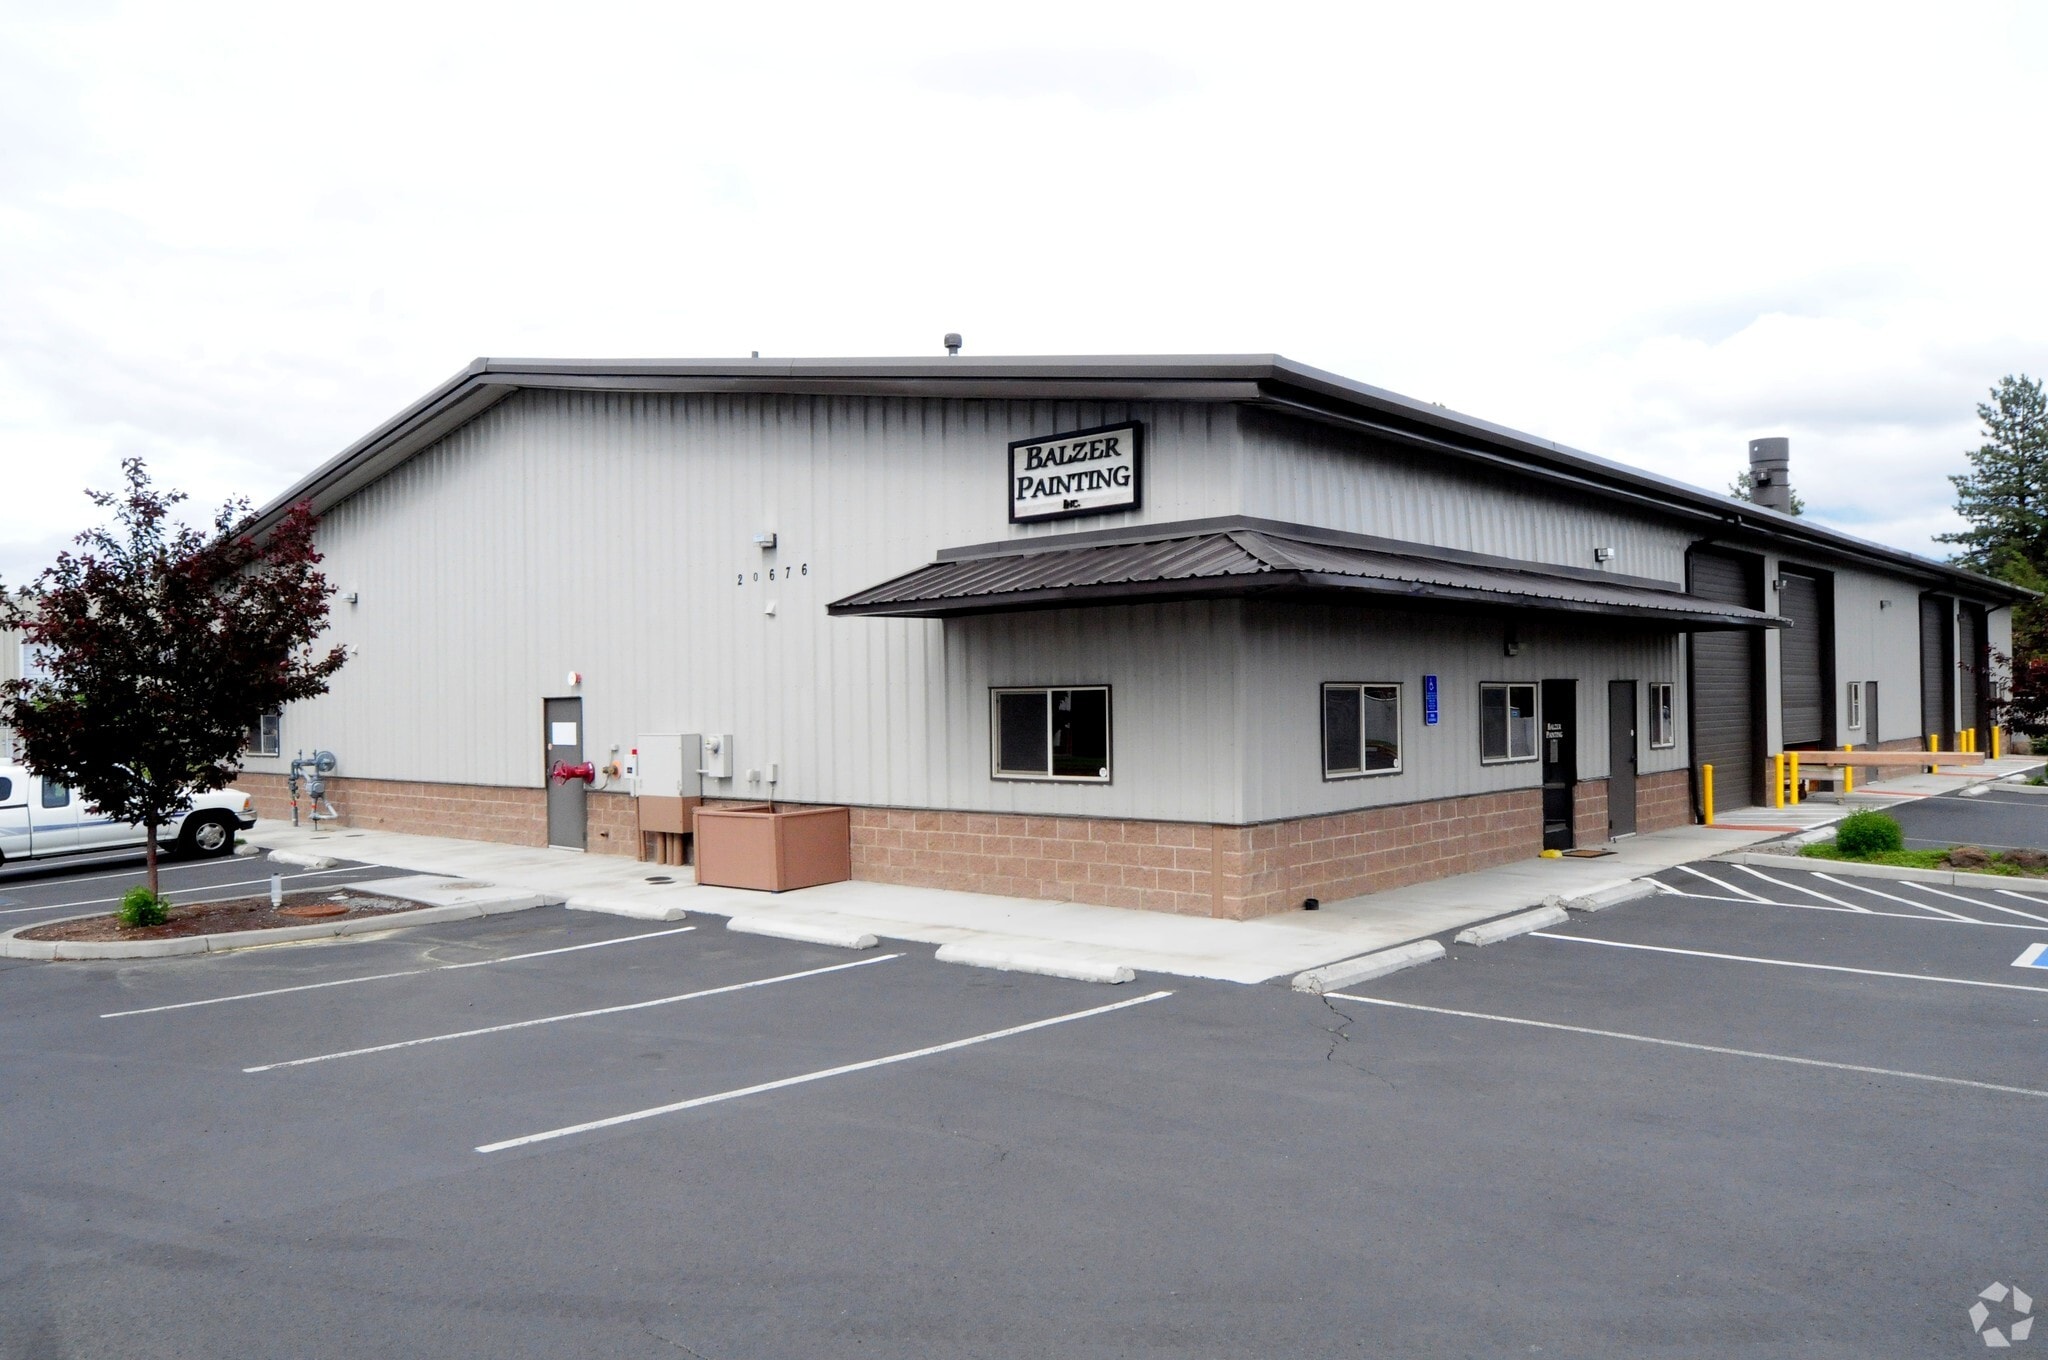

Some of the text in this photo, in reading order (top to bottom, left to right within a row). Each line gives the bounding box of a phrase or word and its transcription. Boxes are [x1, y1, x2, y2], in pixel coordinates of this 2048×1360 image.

[1024, 437, 1121, 471] BALZER
[1016, 465, 1131, 500] PAINTING
[737, 563, 808, 586] 20676
